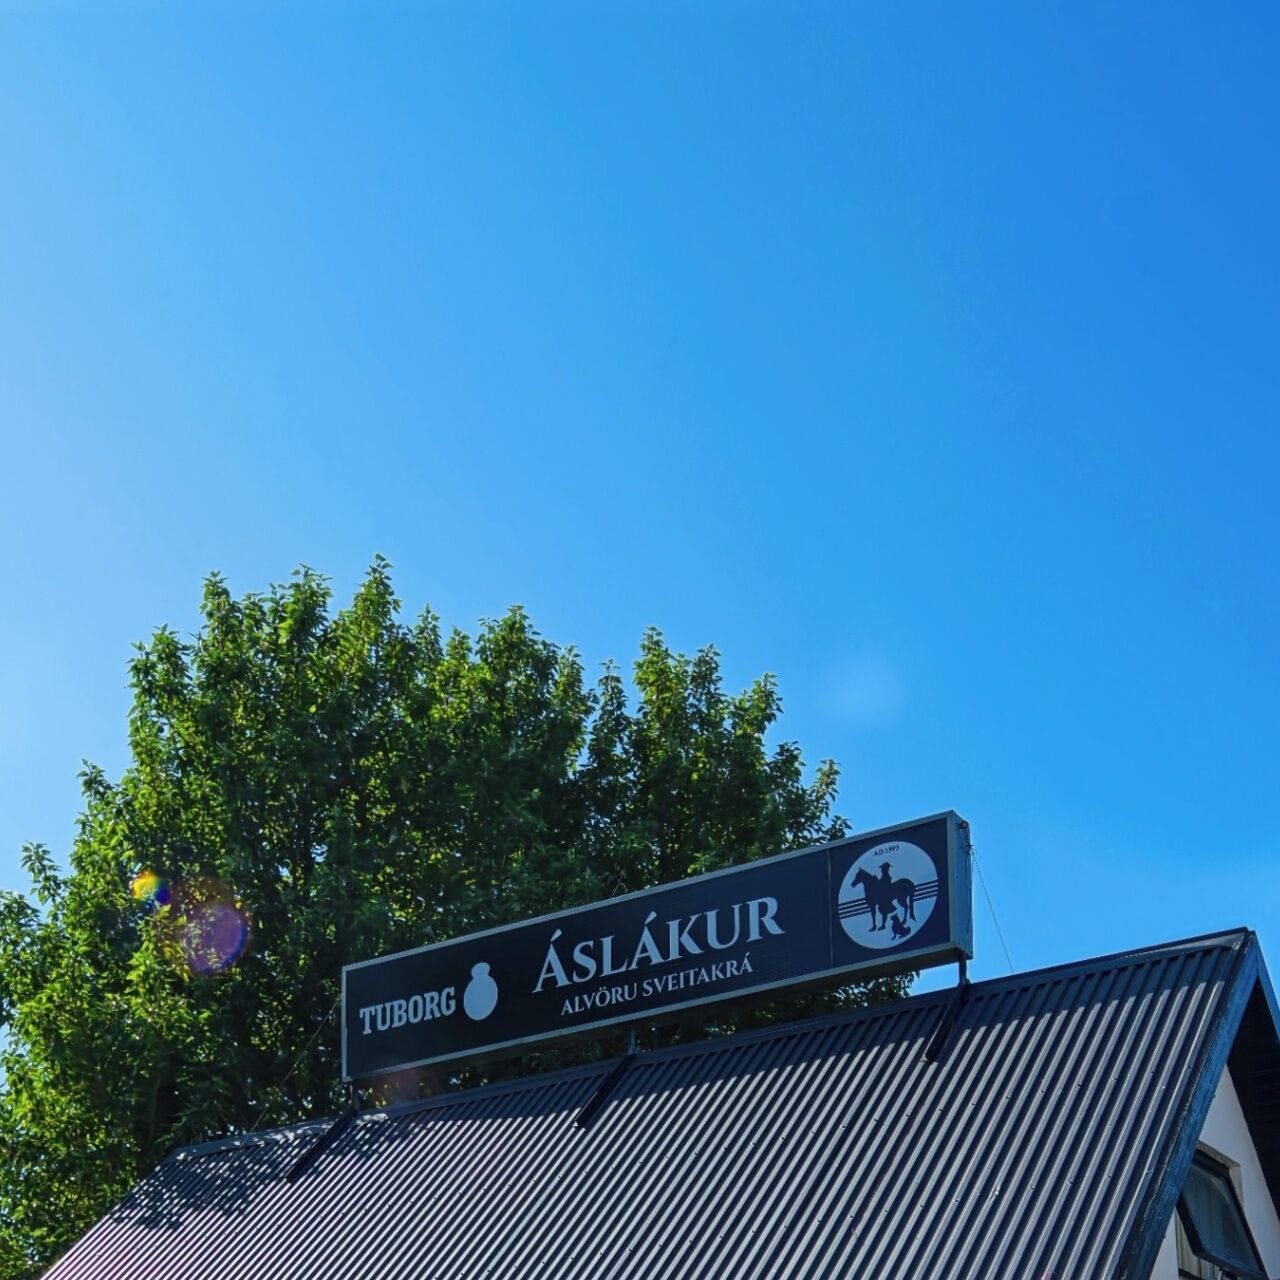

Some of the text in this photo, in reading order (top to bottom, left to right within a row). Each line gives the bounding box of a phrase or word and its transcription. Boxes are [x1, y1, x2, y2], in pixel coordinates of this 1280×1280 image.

[531, 896, 786, 994] ÁSLÁKUR
[359, 986, 456, 1035] TUBORG
[560, 952, 754, 1016] ALVÖRU SVEITAKRÁ
